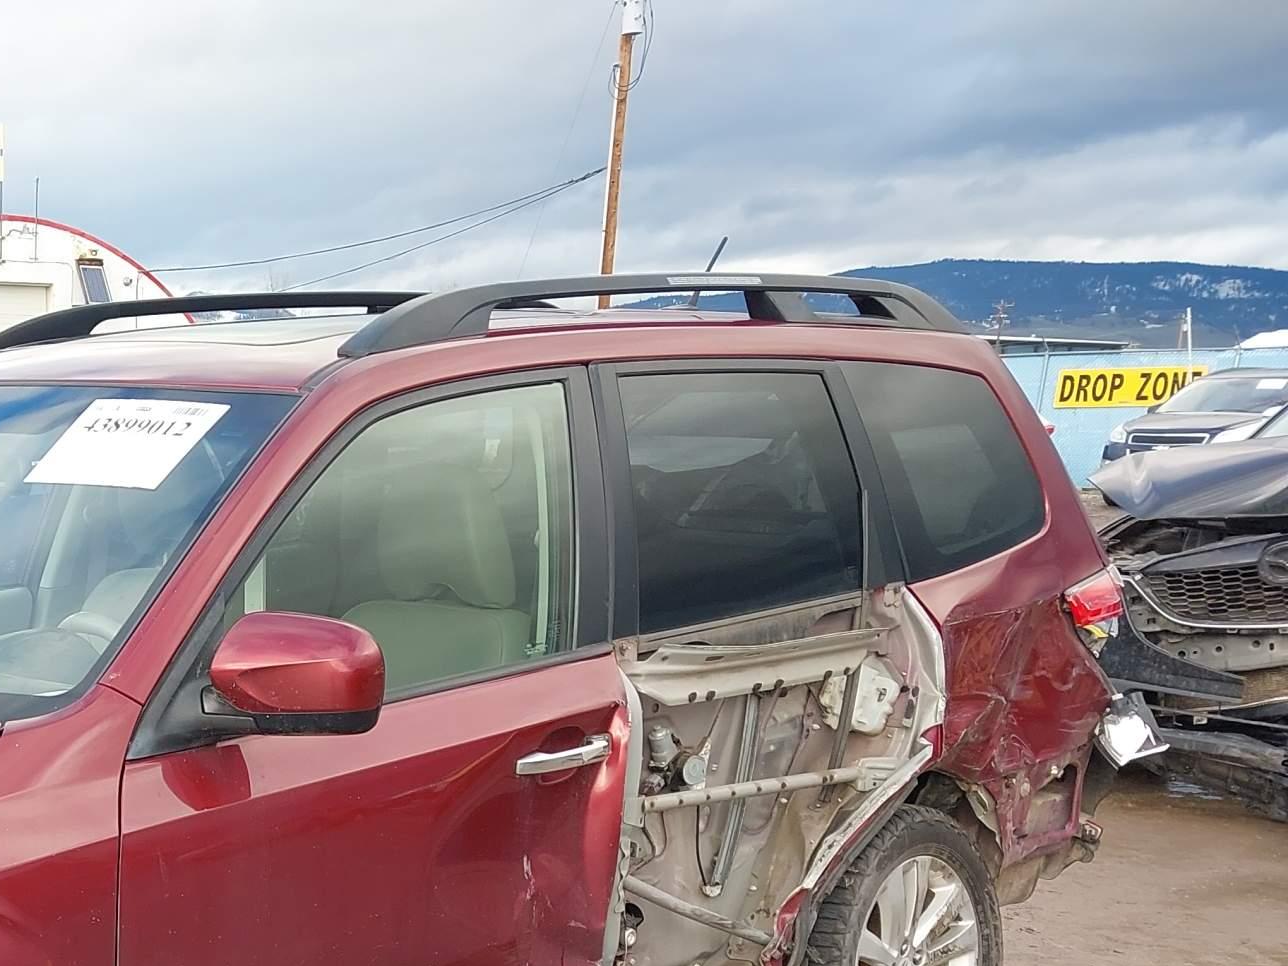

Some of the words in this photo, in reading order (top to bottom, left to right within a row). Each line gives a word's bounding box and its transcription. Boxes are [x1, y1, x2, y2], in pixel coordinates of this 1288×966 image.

[1059, 373, 1124, 402] DROP
[1136, 371, 1203, 401] ZON
[83, 417, 193, 437] 43899012
